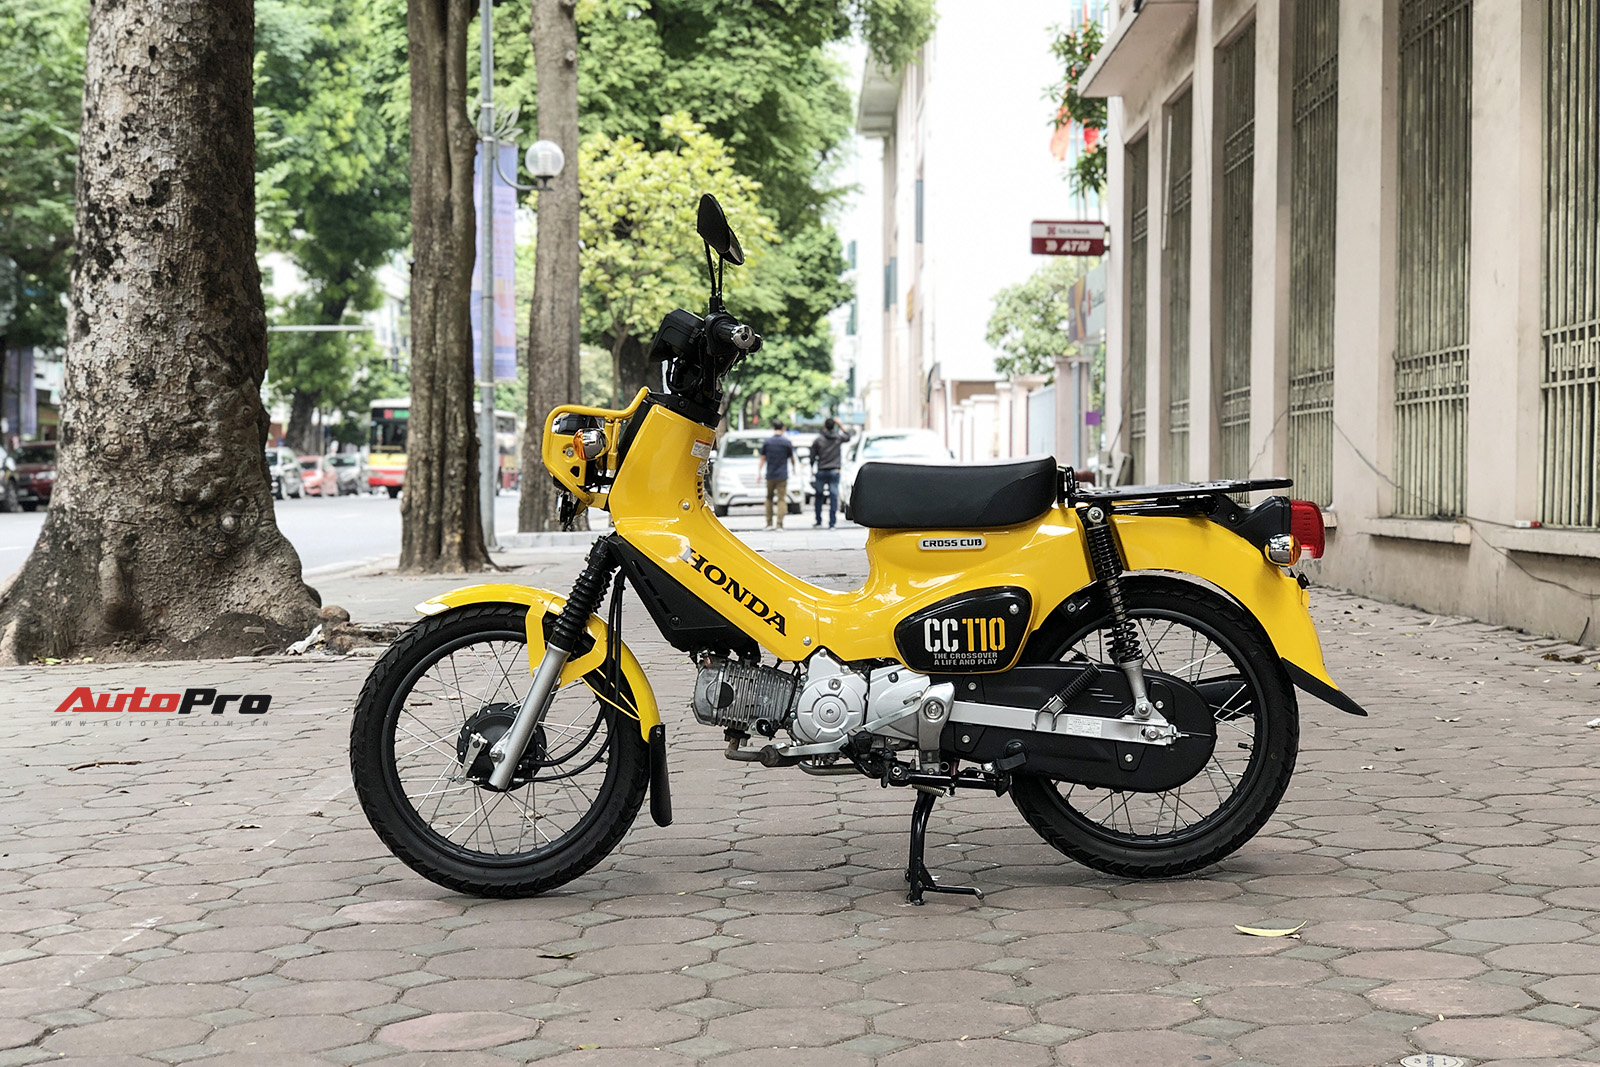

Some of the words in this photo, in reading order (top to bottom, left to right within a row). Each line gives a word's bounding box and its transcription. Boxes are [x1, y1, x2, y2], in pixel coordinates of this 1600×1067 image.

[1060, 240, 1091, 252] ATM
[922, 540, 958, 548] CROSS
[679, 545, 787, 637] HONDA
[924, 618, 959, 653] CC
[961, 617, 1006, 651] 110
